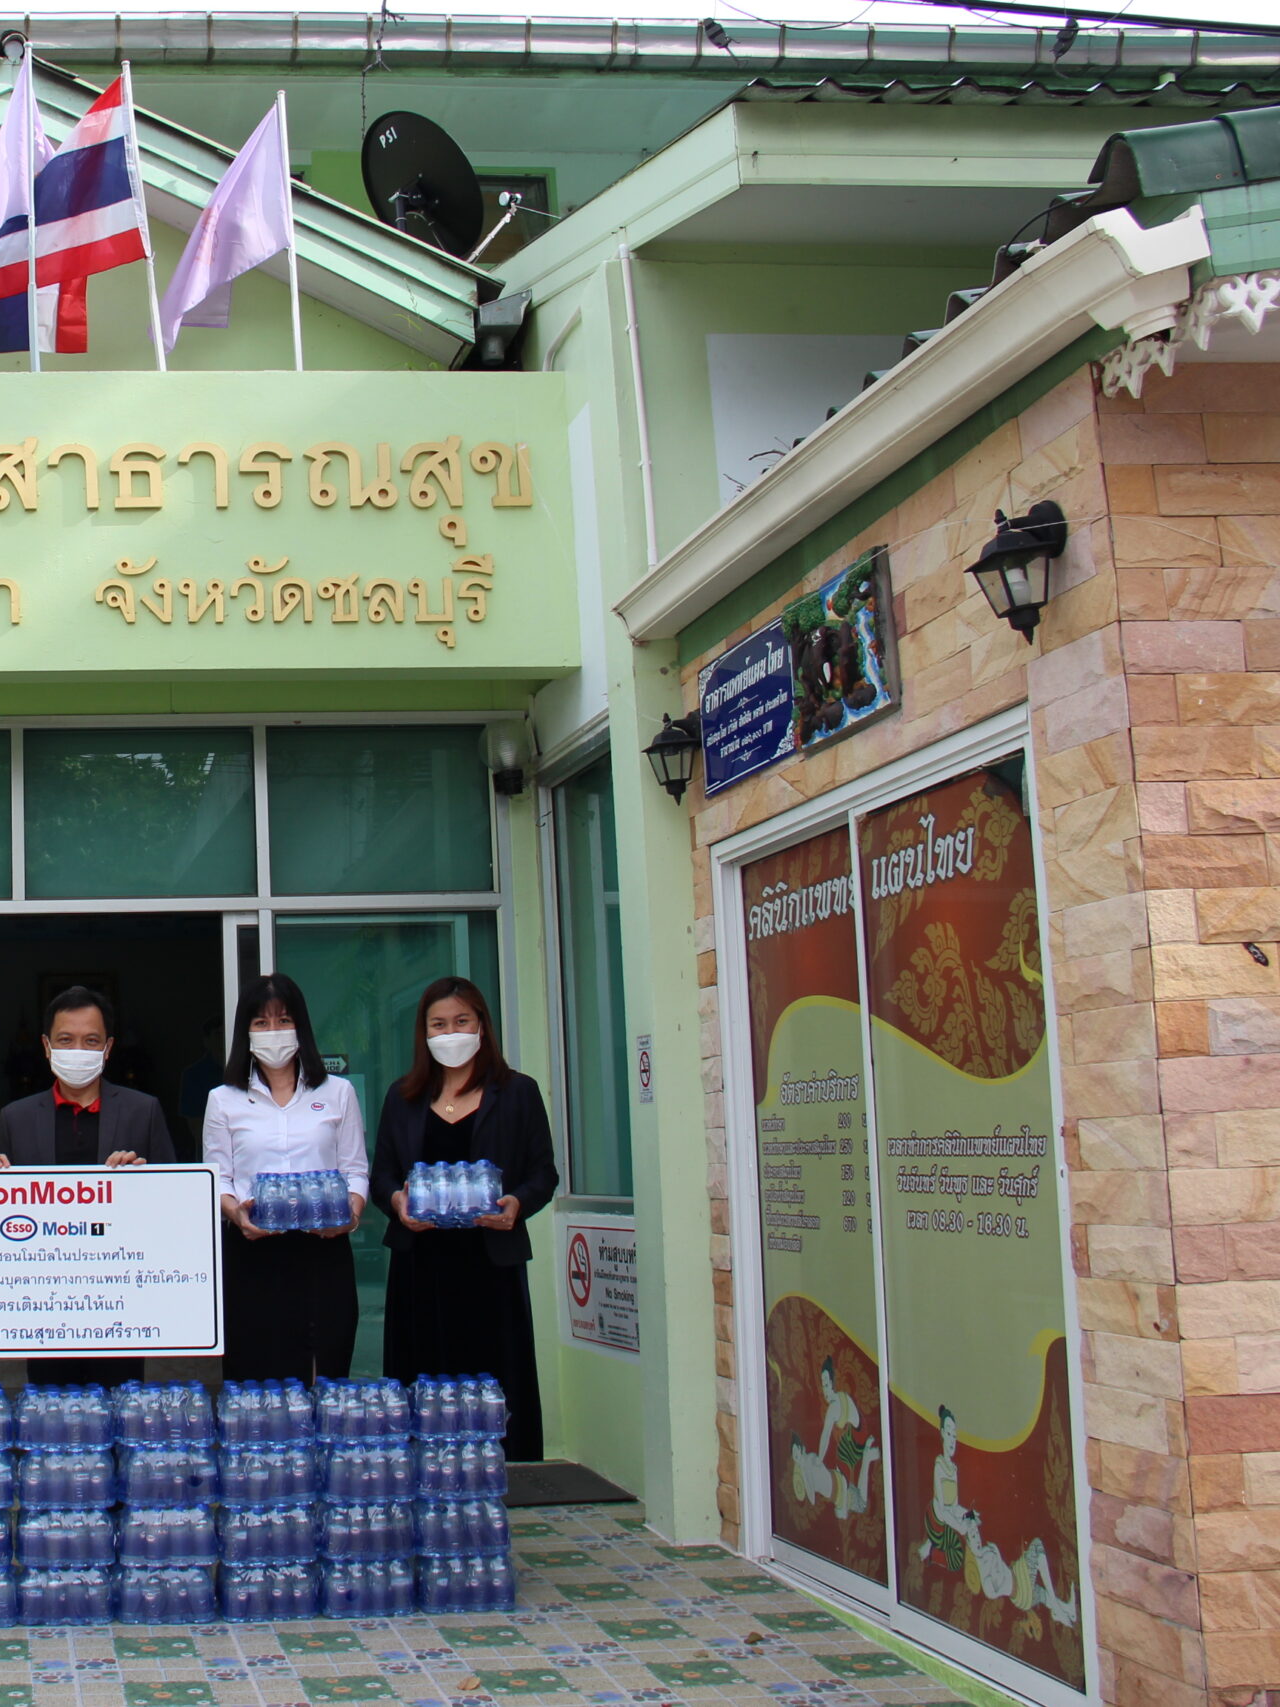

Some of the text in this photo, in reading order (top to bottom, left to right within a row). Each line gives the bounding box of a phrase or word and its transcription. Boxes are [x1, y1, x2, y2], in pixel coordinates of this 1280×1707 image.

[379, 126, 397, 149] PSI
[95, 553, 493, 648] จังหวัดชลบุรี
[748, 812, 975, 941] คลินิกแพทย แผนไทย
[780, 1069, 859, 1105] อัตราค่าบริการ
[896, 1164, 1040, 1206] วันจันทร์ วันพุธ และ วันศุกร์
[5, 1221, 33, 1233] Esso
[42, 1221, 87, 1236] Mobil
[907, 1209, 929, 1230] เวลา
[932, 1209, 964, 1232] 08.30
[1015, 1216, 1030, 1239] น.
[135, 1269, 208, 1288] สู้ภัยโควิด-19
